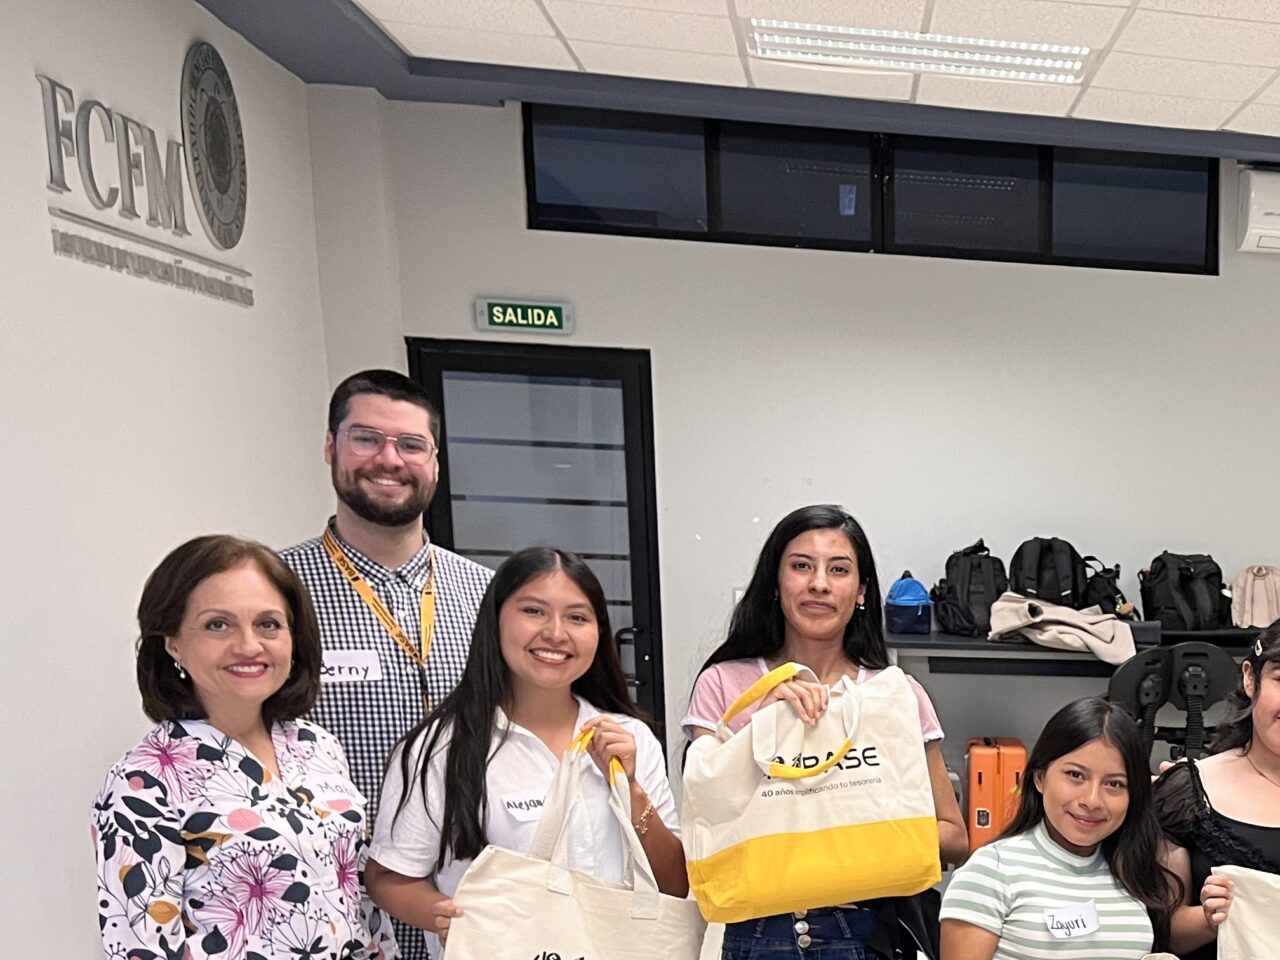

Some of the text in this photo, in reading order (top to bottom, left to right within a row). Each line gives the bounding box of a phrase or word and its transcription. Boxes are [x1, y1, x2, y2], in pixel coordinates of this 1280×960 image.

[35, 73, 192, 238] FCFM
[492, 306, 559, 326] SALIDA
[1047, 914, 1087, 937] Zayuri
